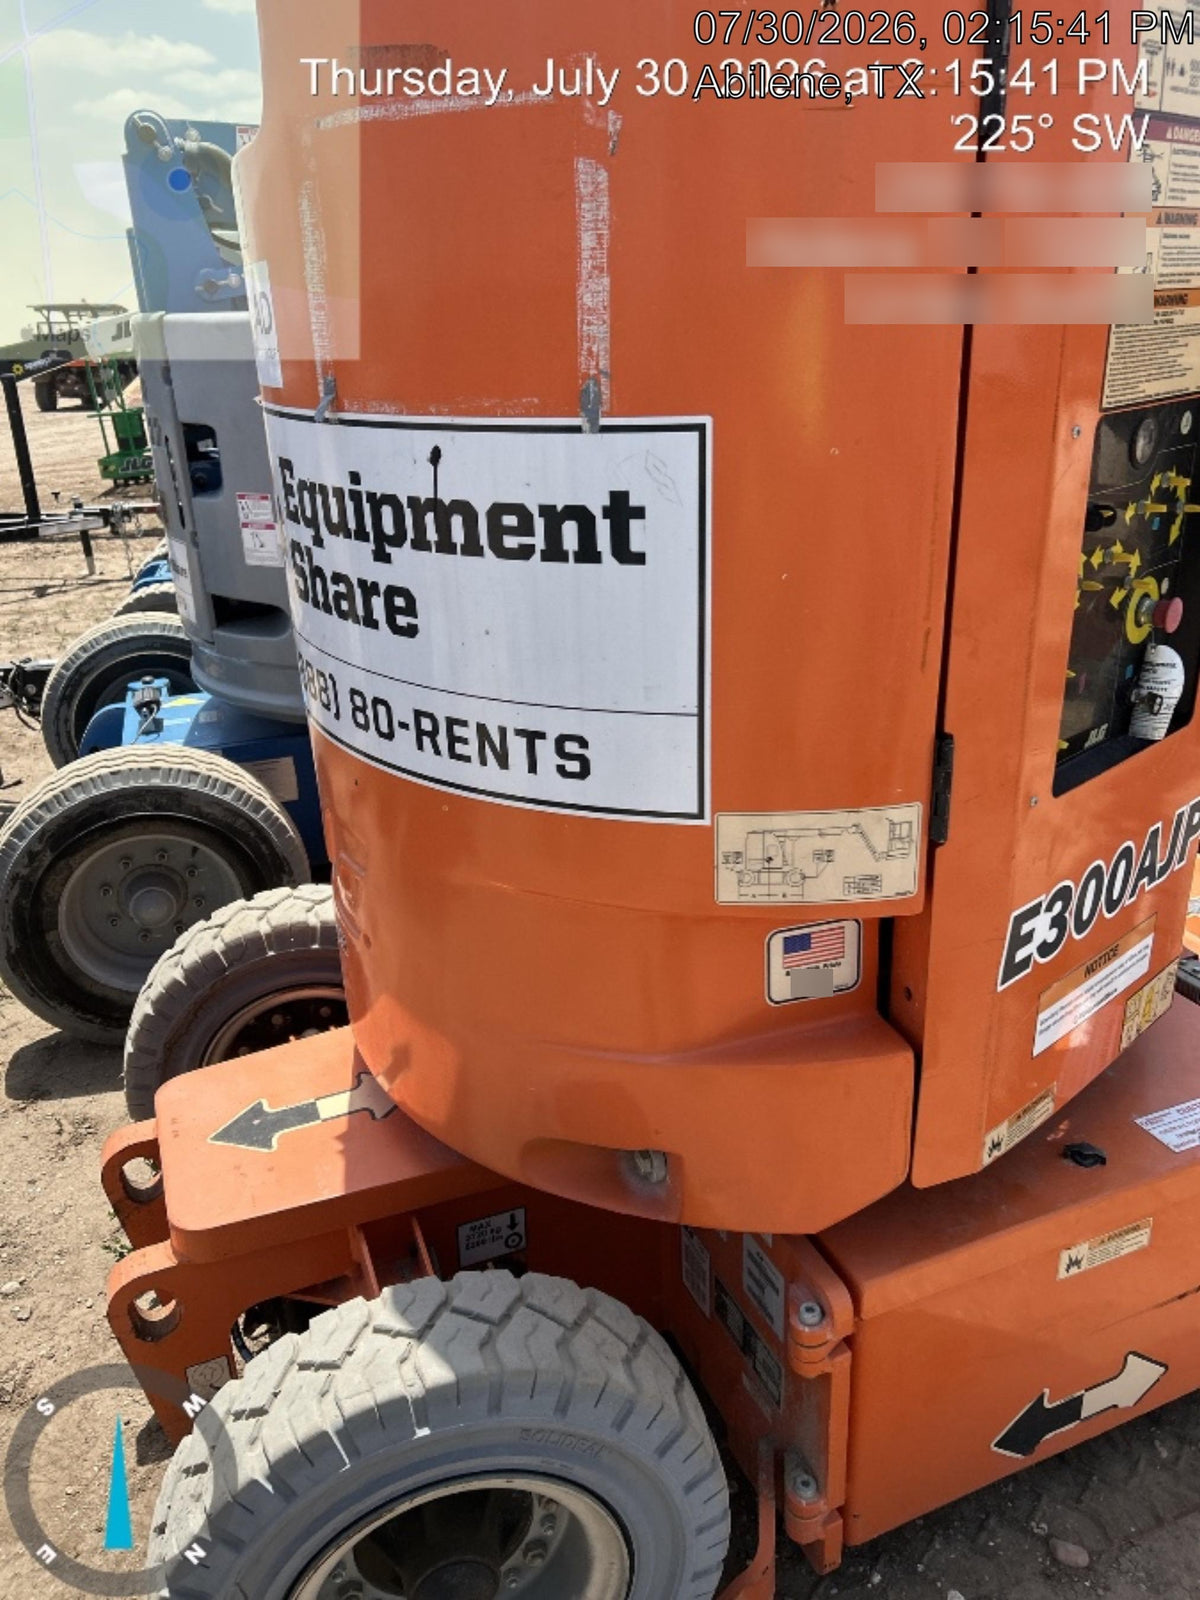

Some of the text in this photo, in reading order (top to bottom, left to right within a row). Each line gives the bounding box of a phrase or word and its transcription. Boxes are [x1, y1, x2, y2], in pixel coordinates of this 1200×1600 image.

[277, 456, 647, 565] Equipment
[290, 538, 419, 638] Share
[349, 686, 592, 781] 80-RENTS
[998, 797, 1200, 991] E300AJP
